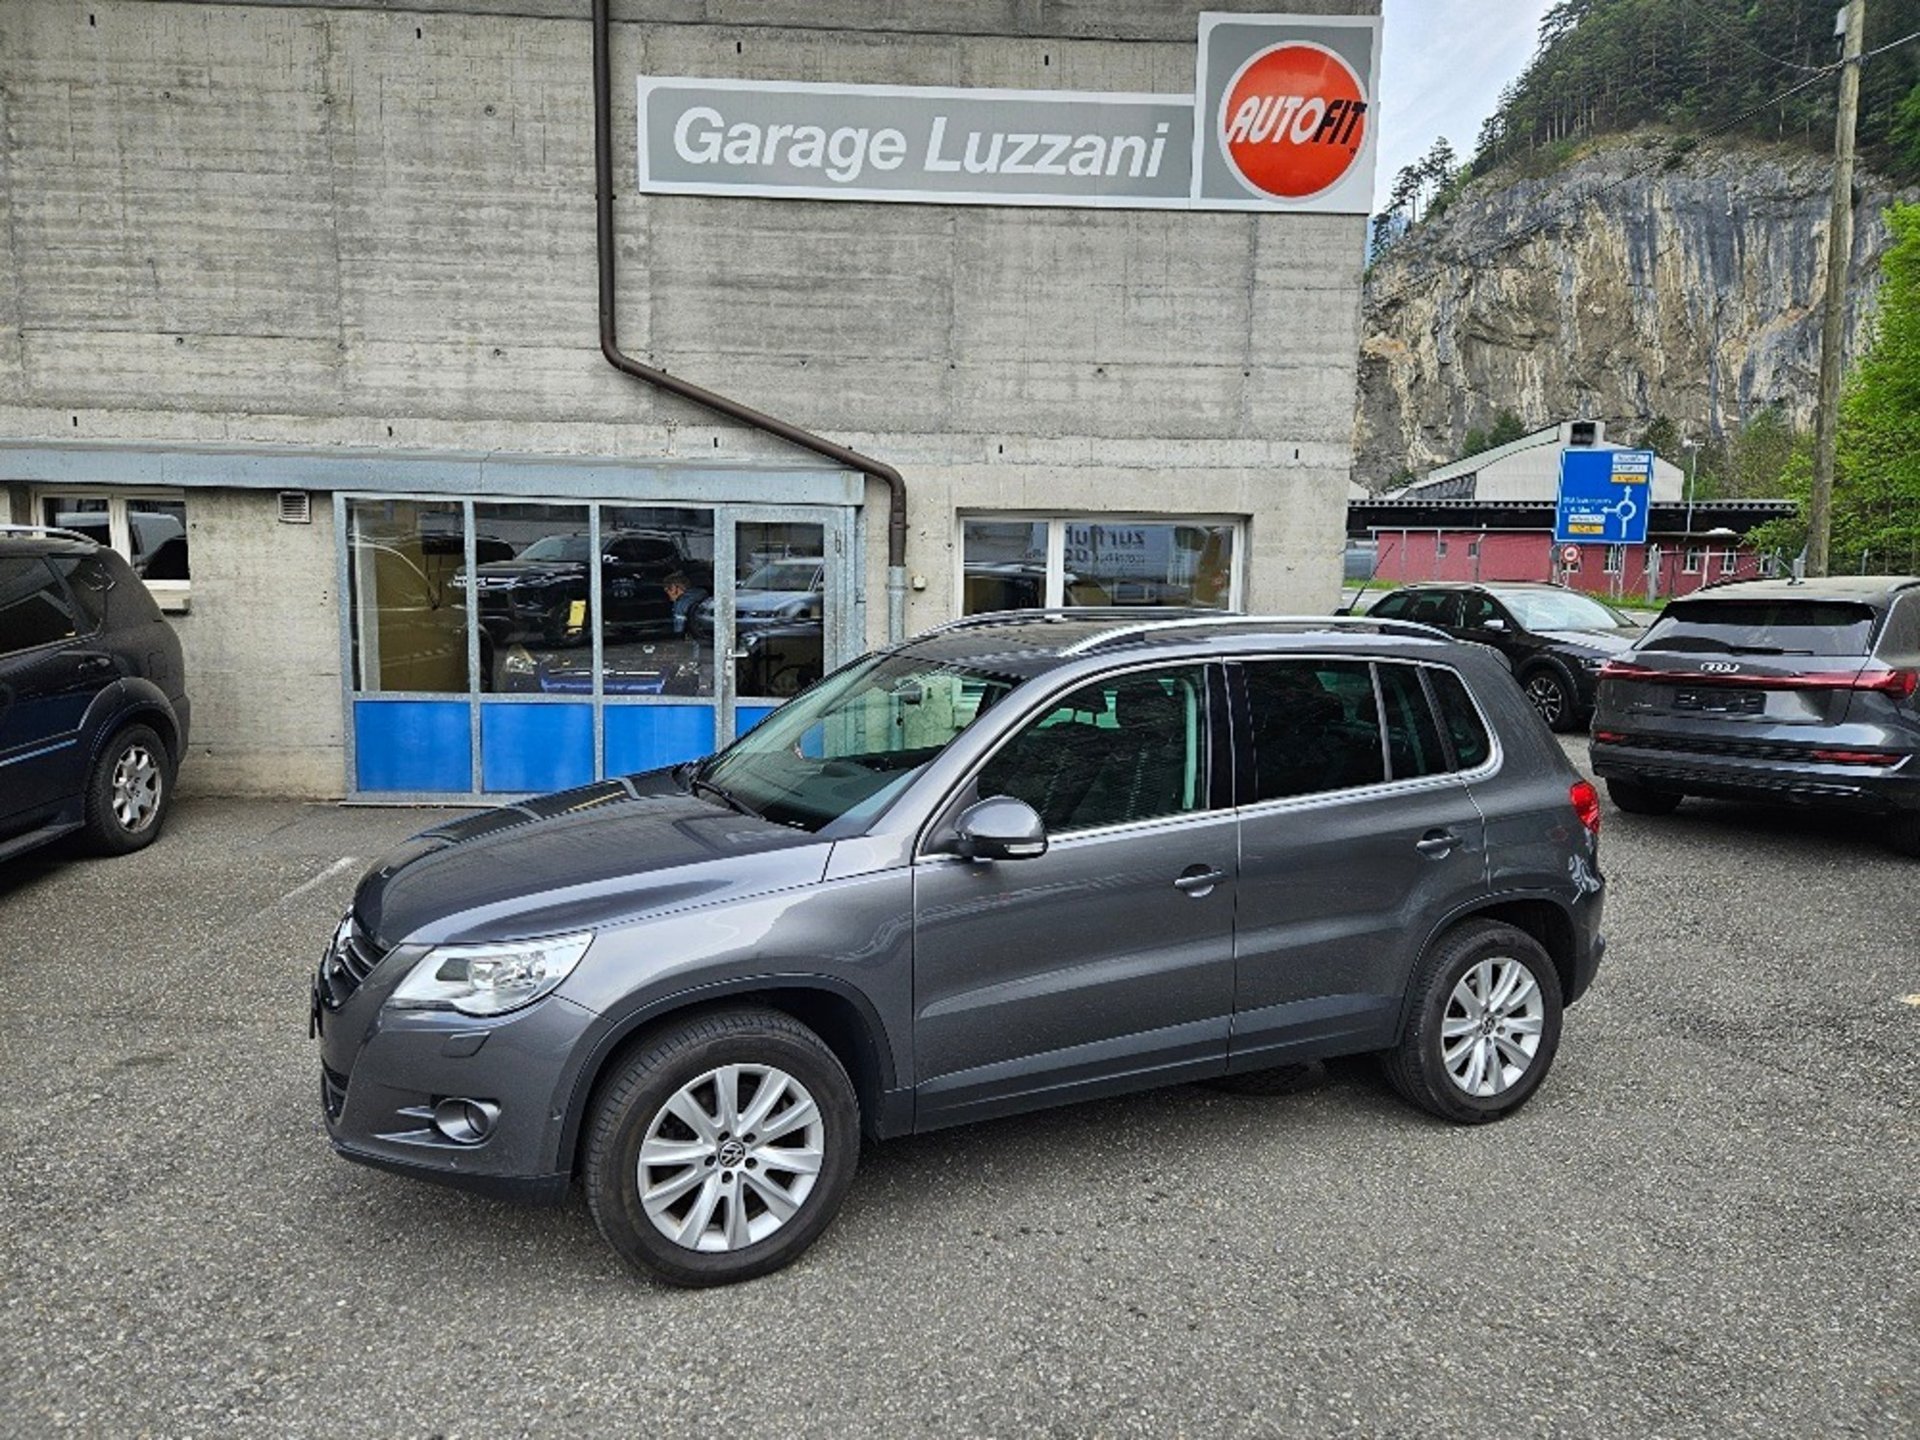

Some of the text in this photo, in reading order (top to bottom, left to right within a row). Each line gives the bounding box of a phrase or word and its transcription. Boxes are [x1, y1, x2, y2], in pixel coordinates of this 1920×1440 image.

[673, 106, 1170, 183] Garage Luzzani
[1227, 96, 1368, 144] AUTOFIT
